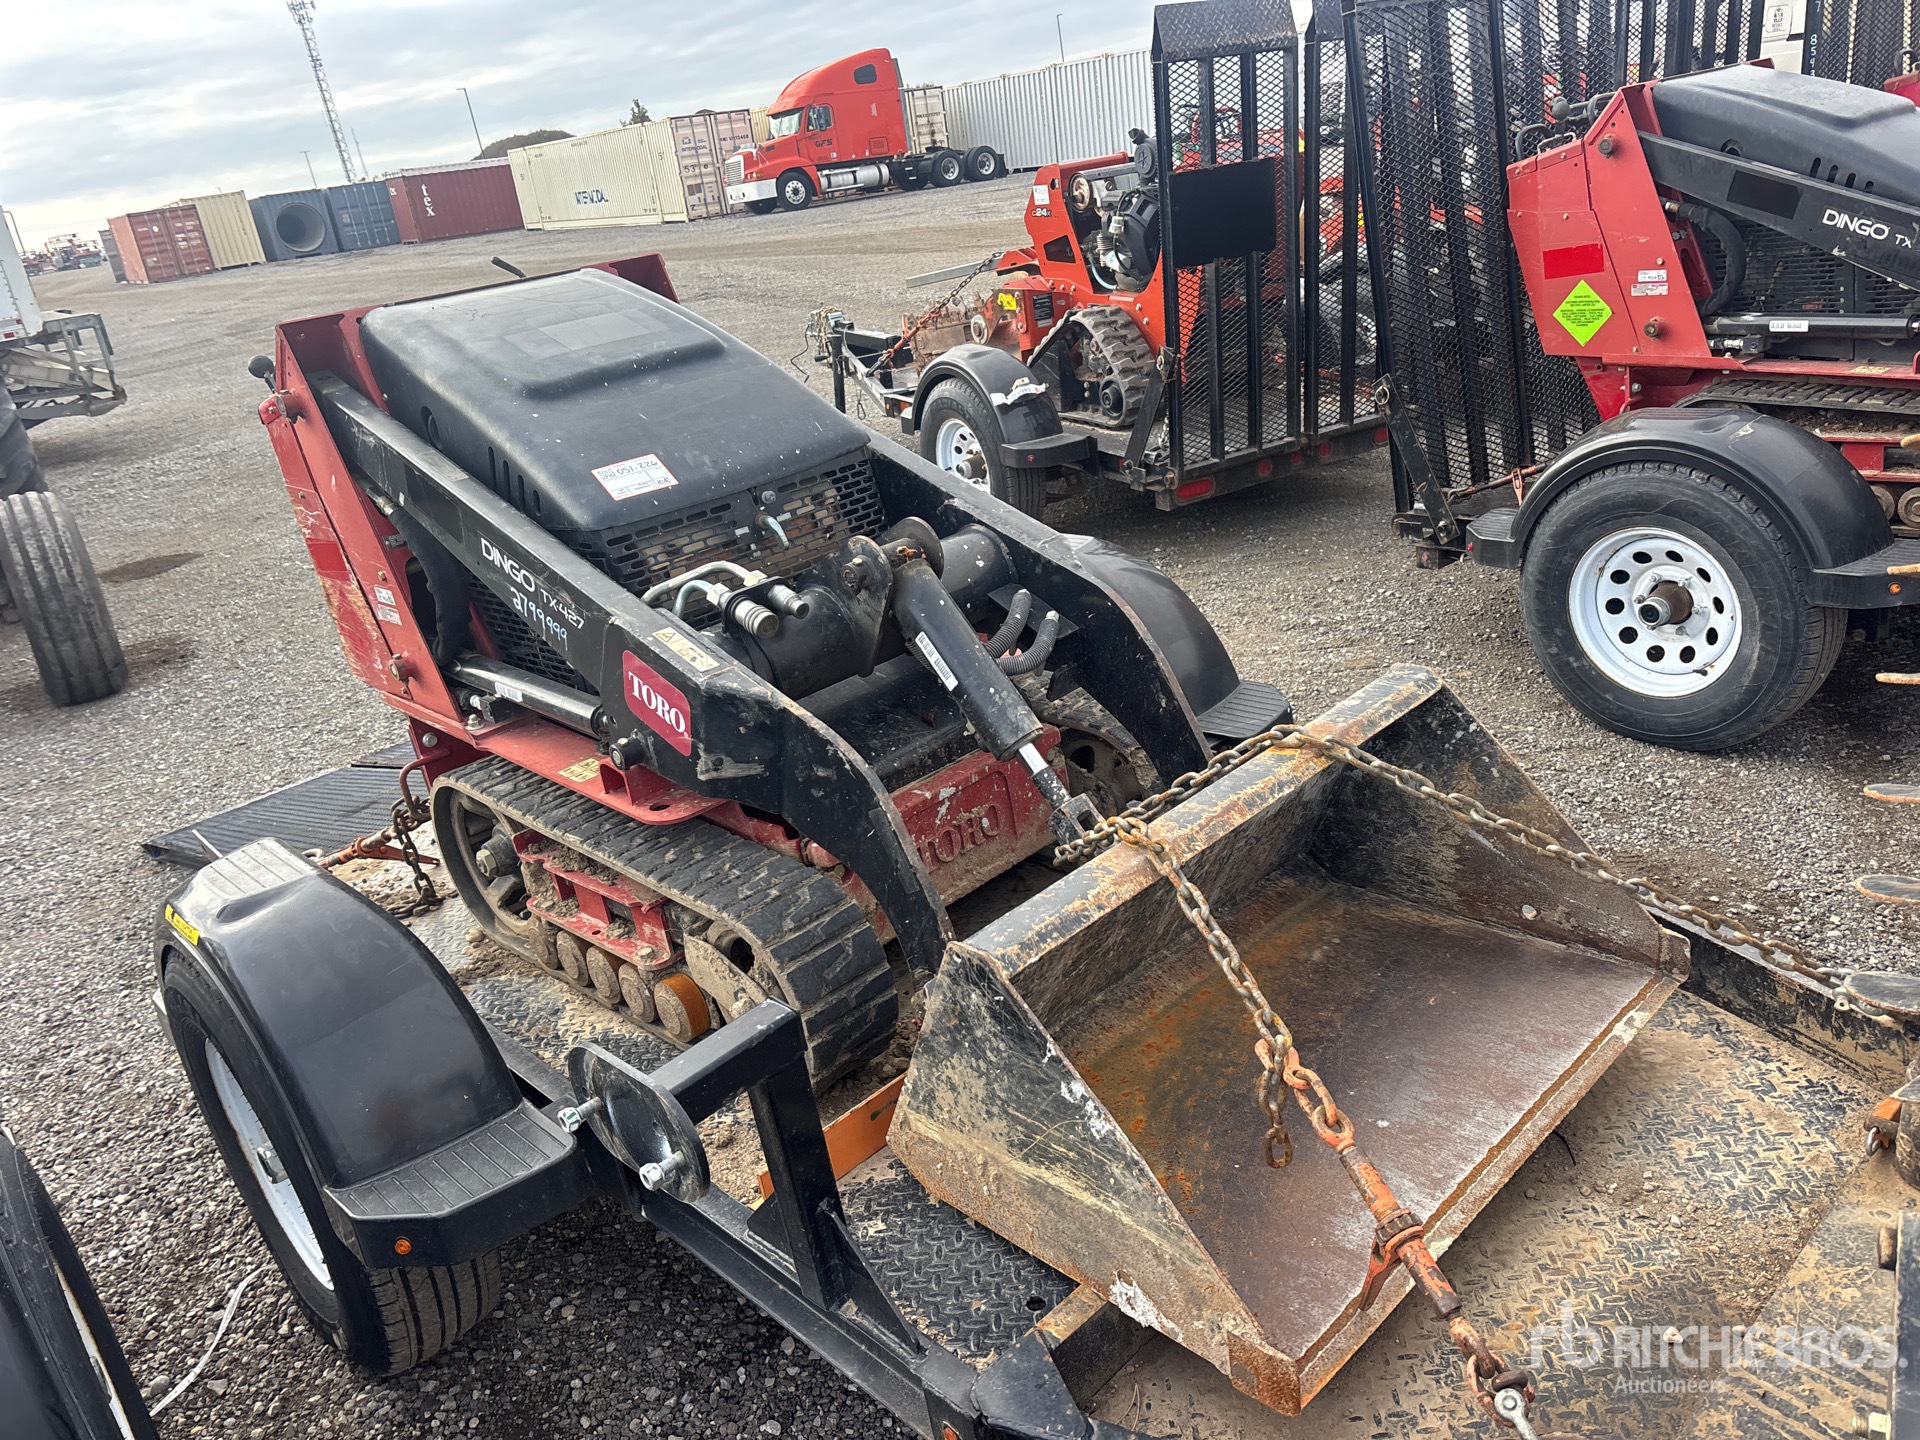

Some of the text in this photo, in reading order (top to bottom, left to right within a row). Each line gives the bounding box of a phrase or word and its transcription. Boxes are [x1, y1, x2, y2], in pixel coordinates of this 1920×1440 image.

[815, 138, 833, 147] GFS
[421, 183, 435, 216] tex
[1822, 208, 1912, 249] DINGO TX
[480, 537, 536, 592] DINGO
[628, 671, 686, 733] TORO
[917, 804, 1000, 873] TORO
